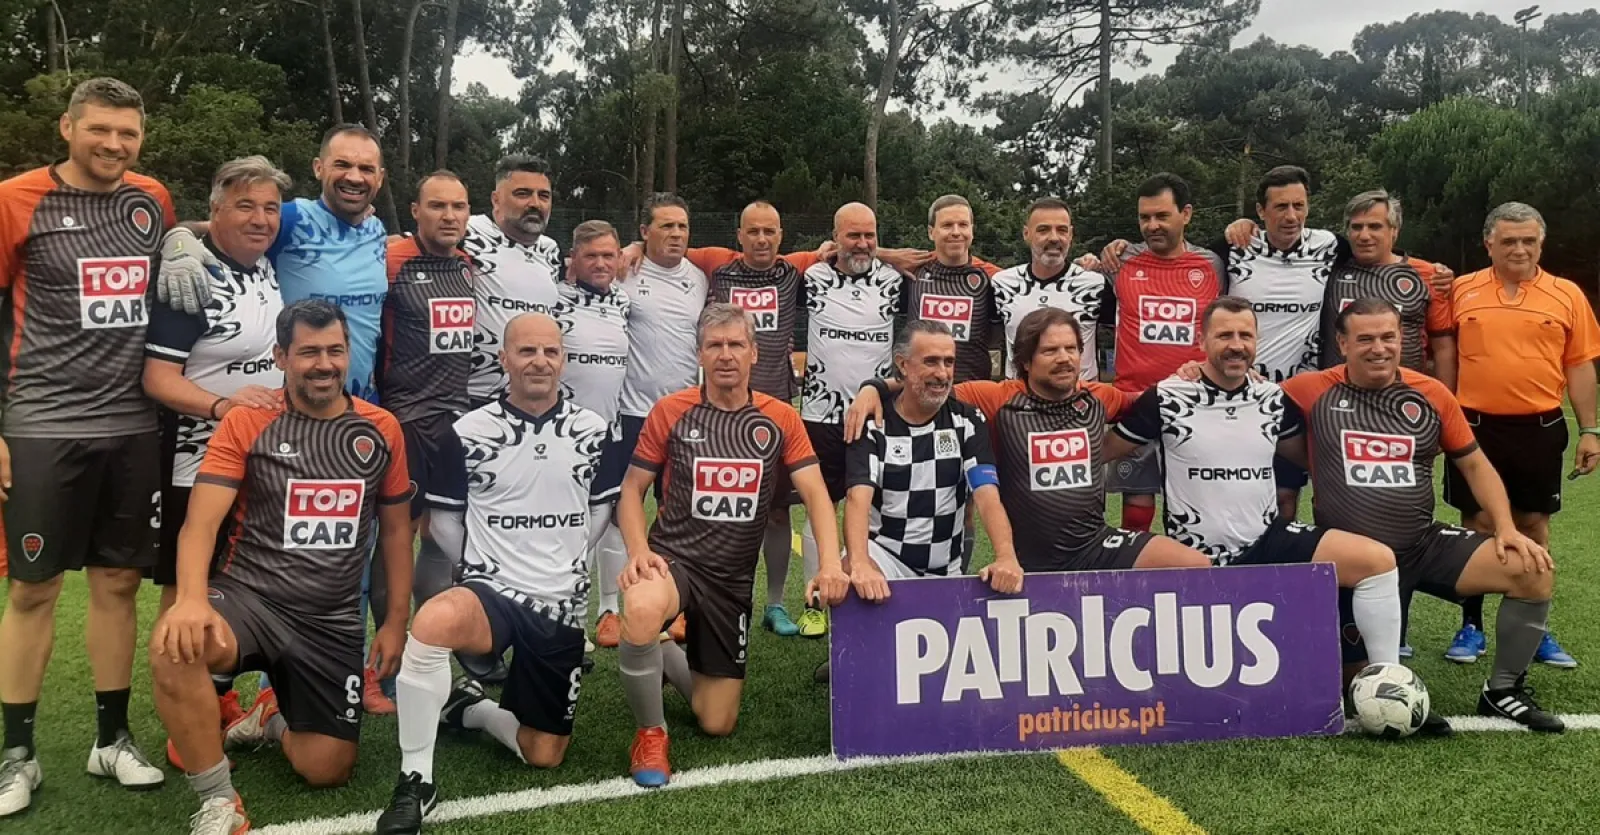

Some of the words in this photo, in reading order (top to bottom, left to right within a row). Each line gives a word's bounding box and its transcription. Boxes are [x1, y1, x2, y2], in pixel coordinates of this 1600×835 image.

[85, 266, 145, 291] TOP
[488, 296, 555, 315] FORMOV
[734, 292, 774, 307] TOP
[925, 300, 969, 317] TOP
[88, 299, 143, 324] CAR
[435, 304, 473, 324] TOP
[1143, 302, 1191, 320] TOP
[436, 331, 472, 350] CAR
[819, 328, 889, 342] FORMOVES
[1143, 324, 1190, 342] CAR
[1034, 437, 1084, 459] TOP
[1347, 437, 1408, 458] TOP
[700, 466, 757, 488] TOP
[1035, 464, 1088, 487] CAR
[1188, 466, 1272, 480] FORMOVE
[1350, 464, 1412, 483] CAR
[150, 490, 162, 528] 3
[294, 488, 357, 511] TOP
[696, 495, 753, 517] CAR
[290, 521, 354, 545] CAR
[738, 612, 747, 647] 9
[895, 592, 1280, 704] PATRICIUS
[1018, 701, 1166, 741] patricius.pt
